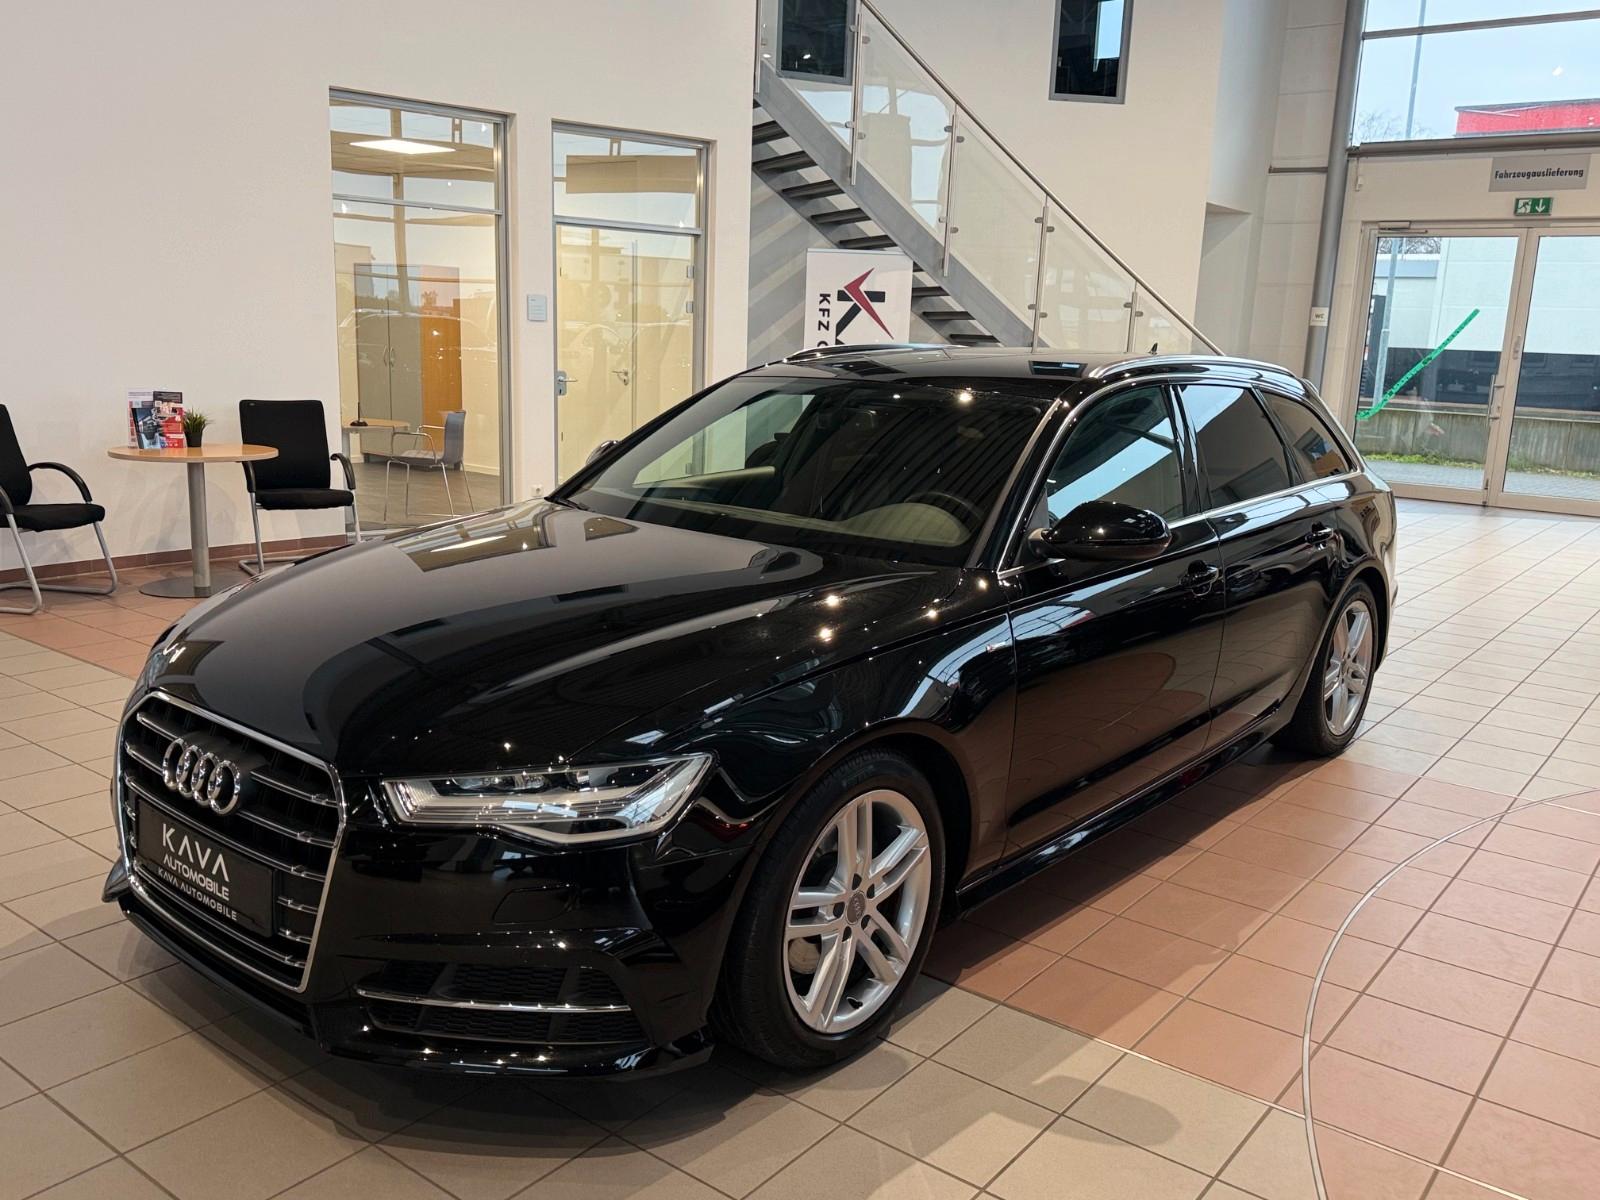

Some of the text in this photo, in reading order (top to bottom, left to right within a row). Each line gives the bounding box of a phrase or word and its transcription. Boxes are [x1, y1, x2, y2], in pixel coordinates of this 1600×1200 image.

[1495, 168, 1584, 179] Fahrzeugauslieferung
[817, 293, 831, 331] KFZ
[162, 823, 230, 882] KAVA
[158, 867, 237, 921] KAVA AUTOMOBILE
[163, 854, 230, 901] AUTOMOBILE
